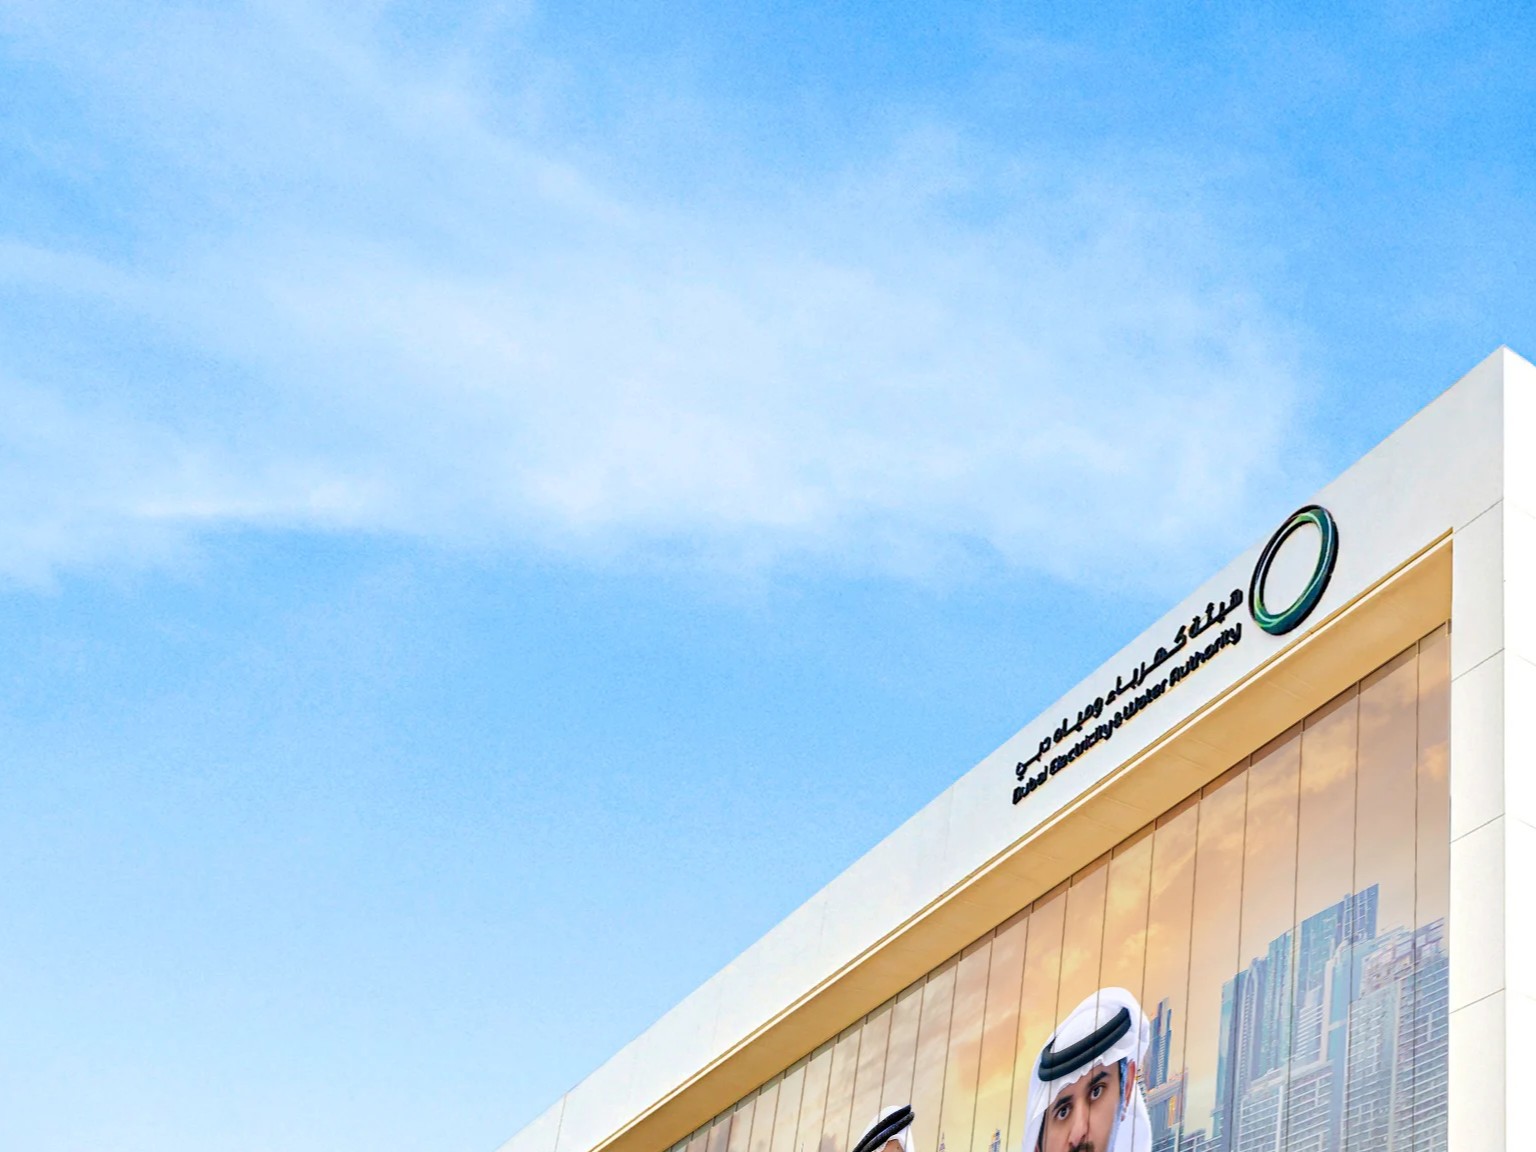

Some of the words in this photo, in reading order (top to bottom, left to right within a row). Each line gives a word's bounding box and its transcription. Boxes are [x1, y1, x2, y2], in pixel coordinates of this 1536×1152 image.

[1012, 765, 1048, 805] Dubai
[1049, 719, 1112, 776] Electricity
[1123, 678, 1168, 721] Water
[1169, 622, 1242, 687] Authority
[1016, 736, 1051, 781] دبي
